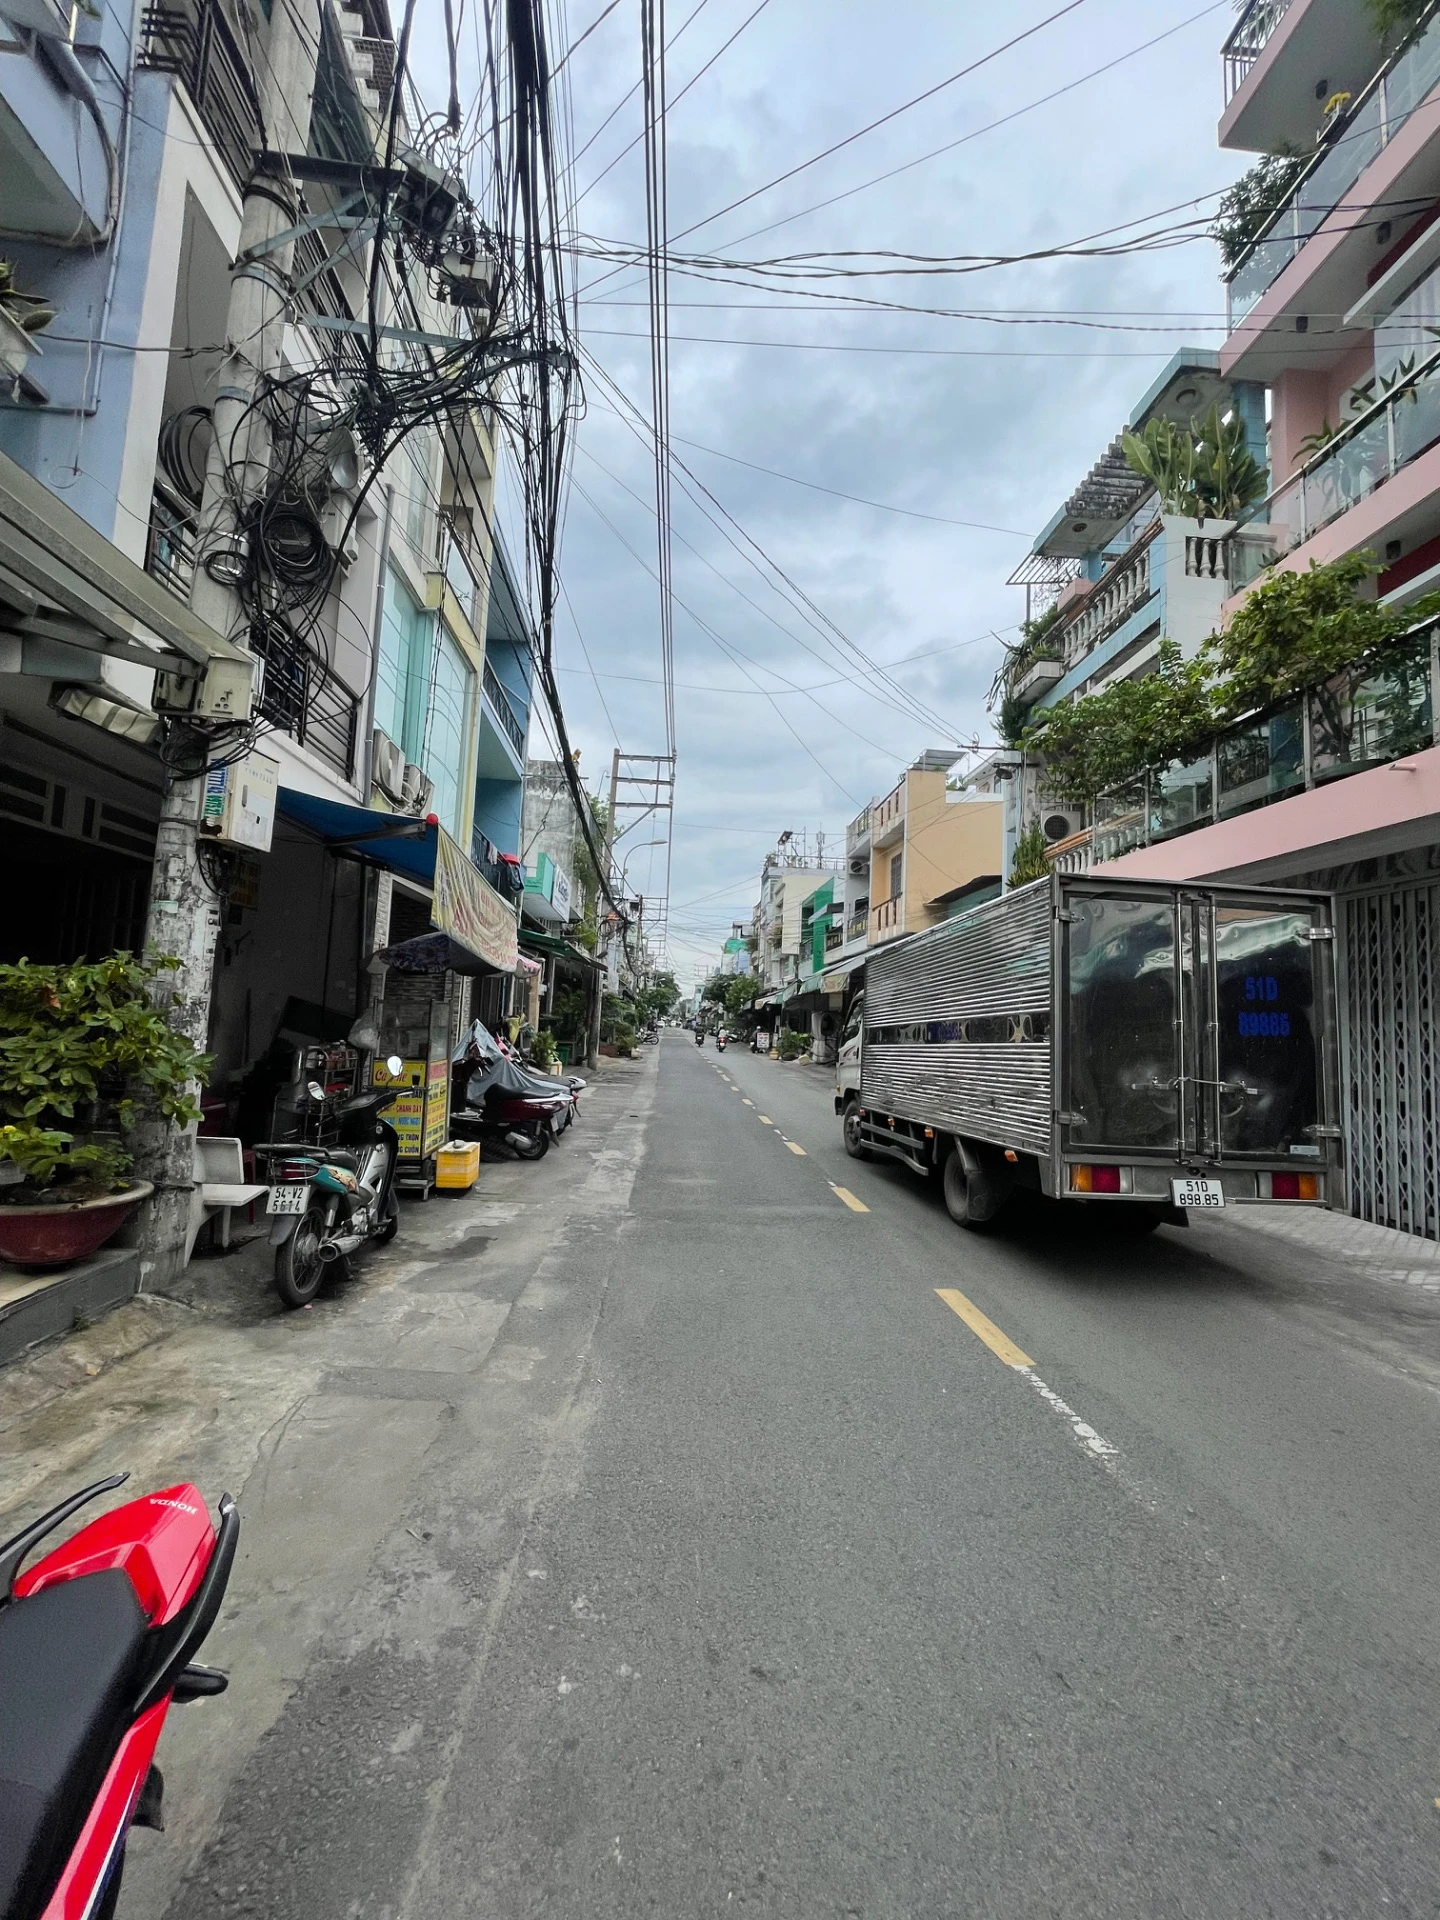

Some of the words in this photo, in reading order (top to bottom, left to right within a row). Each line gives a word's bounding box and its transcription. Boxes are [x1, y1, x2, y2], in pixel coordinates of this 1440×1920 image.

[1245, 976, 1278, 1000] 51D
[1186, 1181, 1208, 1192] 51D
[275, 1187, 304, 1199] 54-V2
[1179, 1193, 1219, 1206] 898.85
[272, 1200, 300, 1212] 5614
[149, 1498, 197, 1515] HONDA
